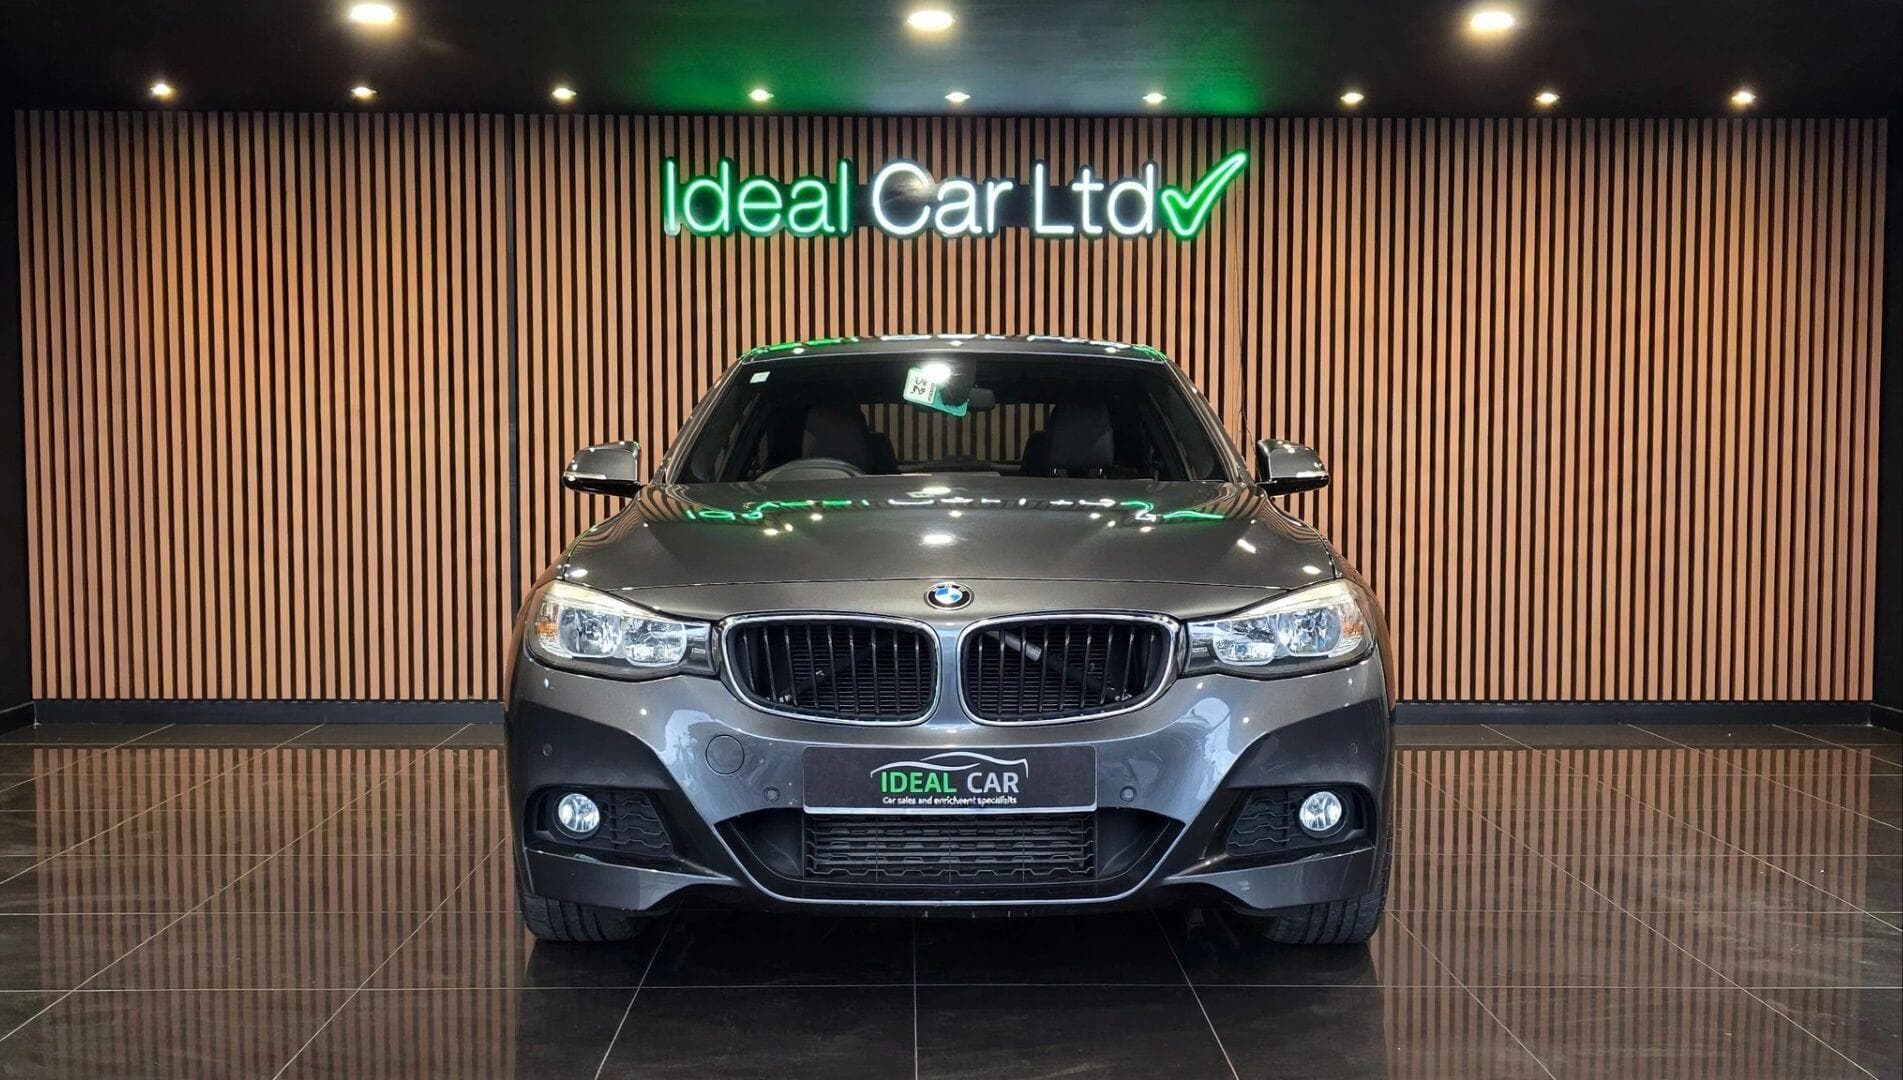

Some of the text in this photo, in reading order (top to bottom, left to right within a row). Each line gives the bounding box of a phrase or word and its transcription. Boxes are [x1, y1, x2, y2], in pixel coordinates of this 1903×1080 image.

[663, 158, 1156, 237] Ideal Car Ltd
[880, 771, 1020, 793] IDEAL CAR
[882, 796, 896, 805] Car
[897, 796, 916, 805] sales
[918, 795, 933, 805] and
